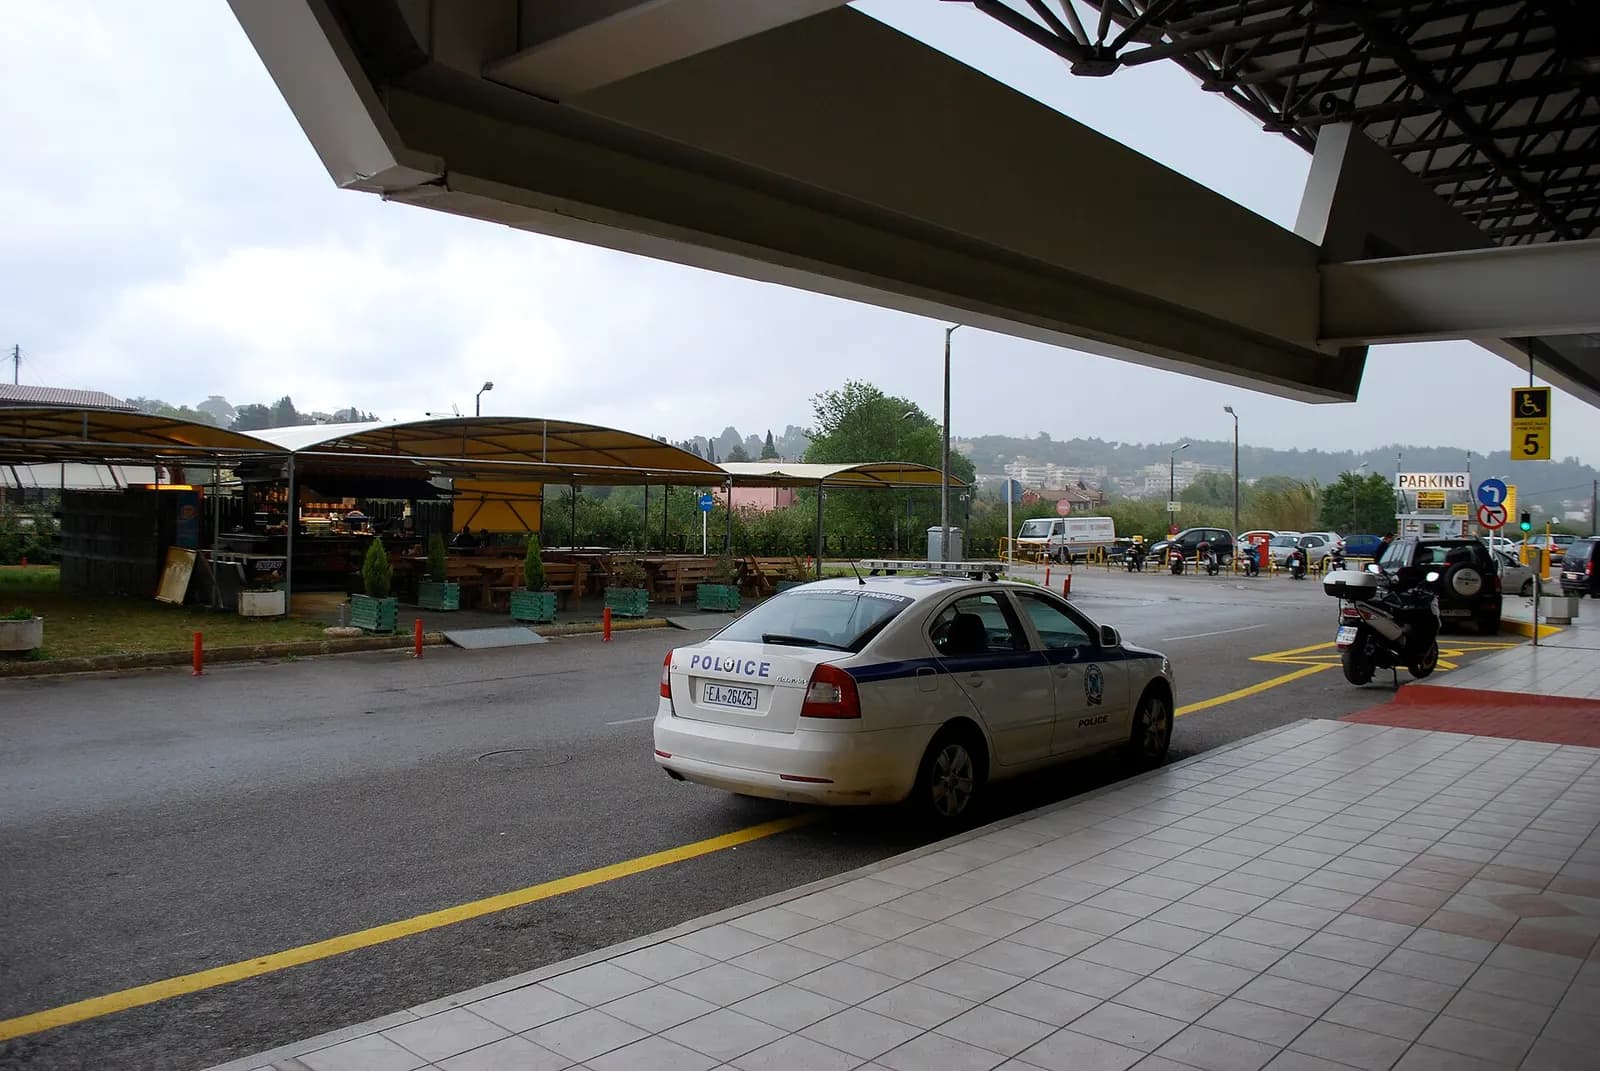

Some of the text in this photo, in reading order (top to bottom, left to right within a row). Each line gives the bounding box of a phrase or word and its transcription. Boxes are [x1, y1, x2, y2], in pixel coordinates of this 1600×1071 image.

[1523, 433, 1539, 456] 5
[1399, 475, 1465, 488] PARKING
[690, 654, 771, 678] POLICE
[708, 686, 753, 706] EA 26425
[1078, 714, 1109, 729] POLICE
